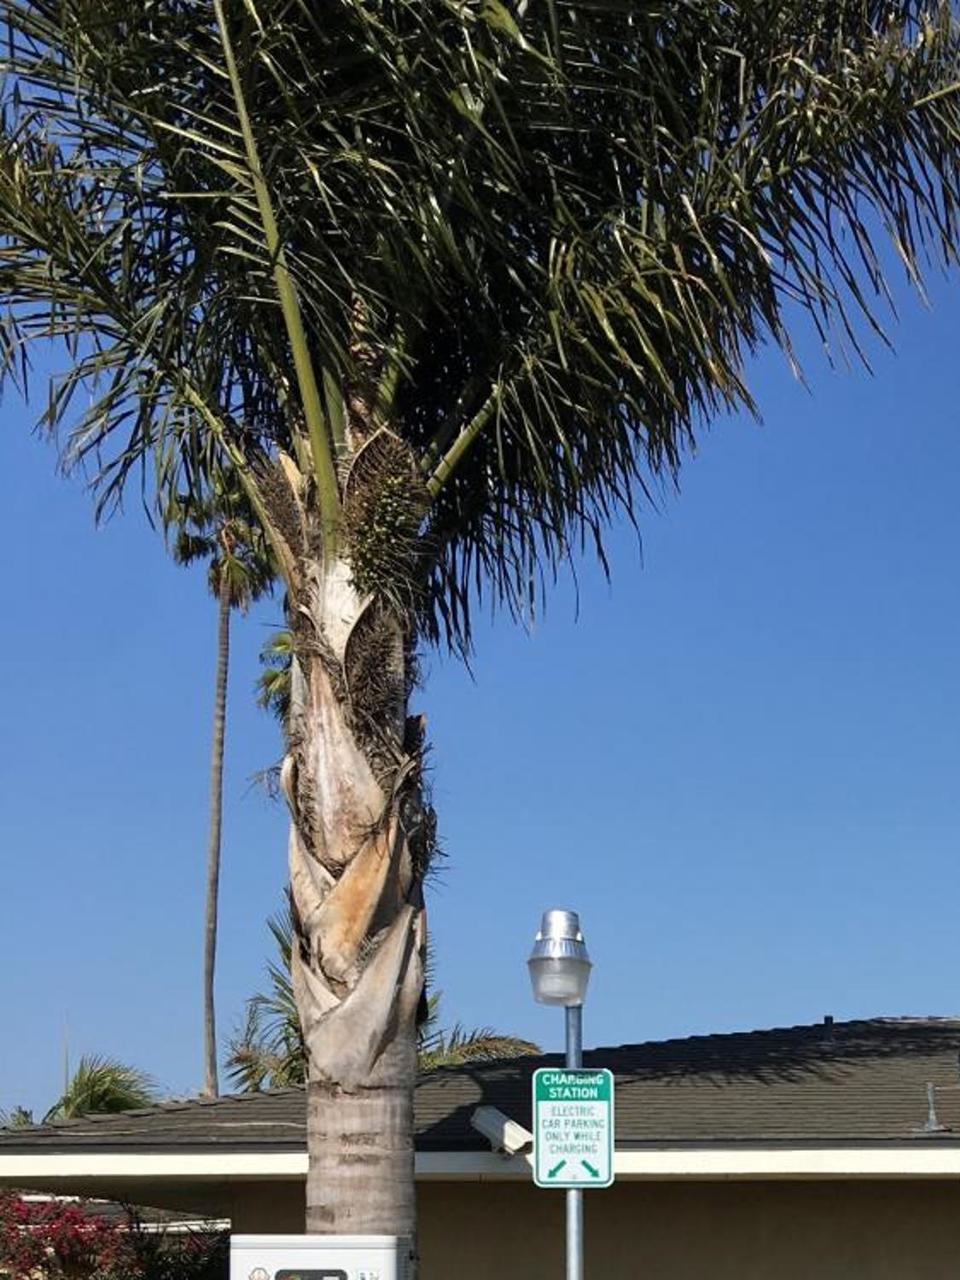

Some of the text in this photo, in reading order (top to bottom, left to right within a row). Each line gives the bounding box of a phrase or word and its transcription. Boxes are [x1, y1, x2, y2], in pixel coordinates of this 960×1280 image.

[542, 1073, 604, 1085] CHARGING
[549, 1087, 598, 1098] STATION
[550, 1105, 596, 1116] ELECTRIC
[542, 1119, 605, 1129] CAR PARKING
[546, 1131, 601, 1141] ONLY WHILE
[549, 1144, 598, 1154] CHARGING
